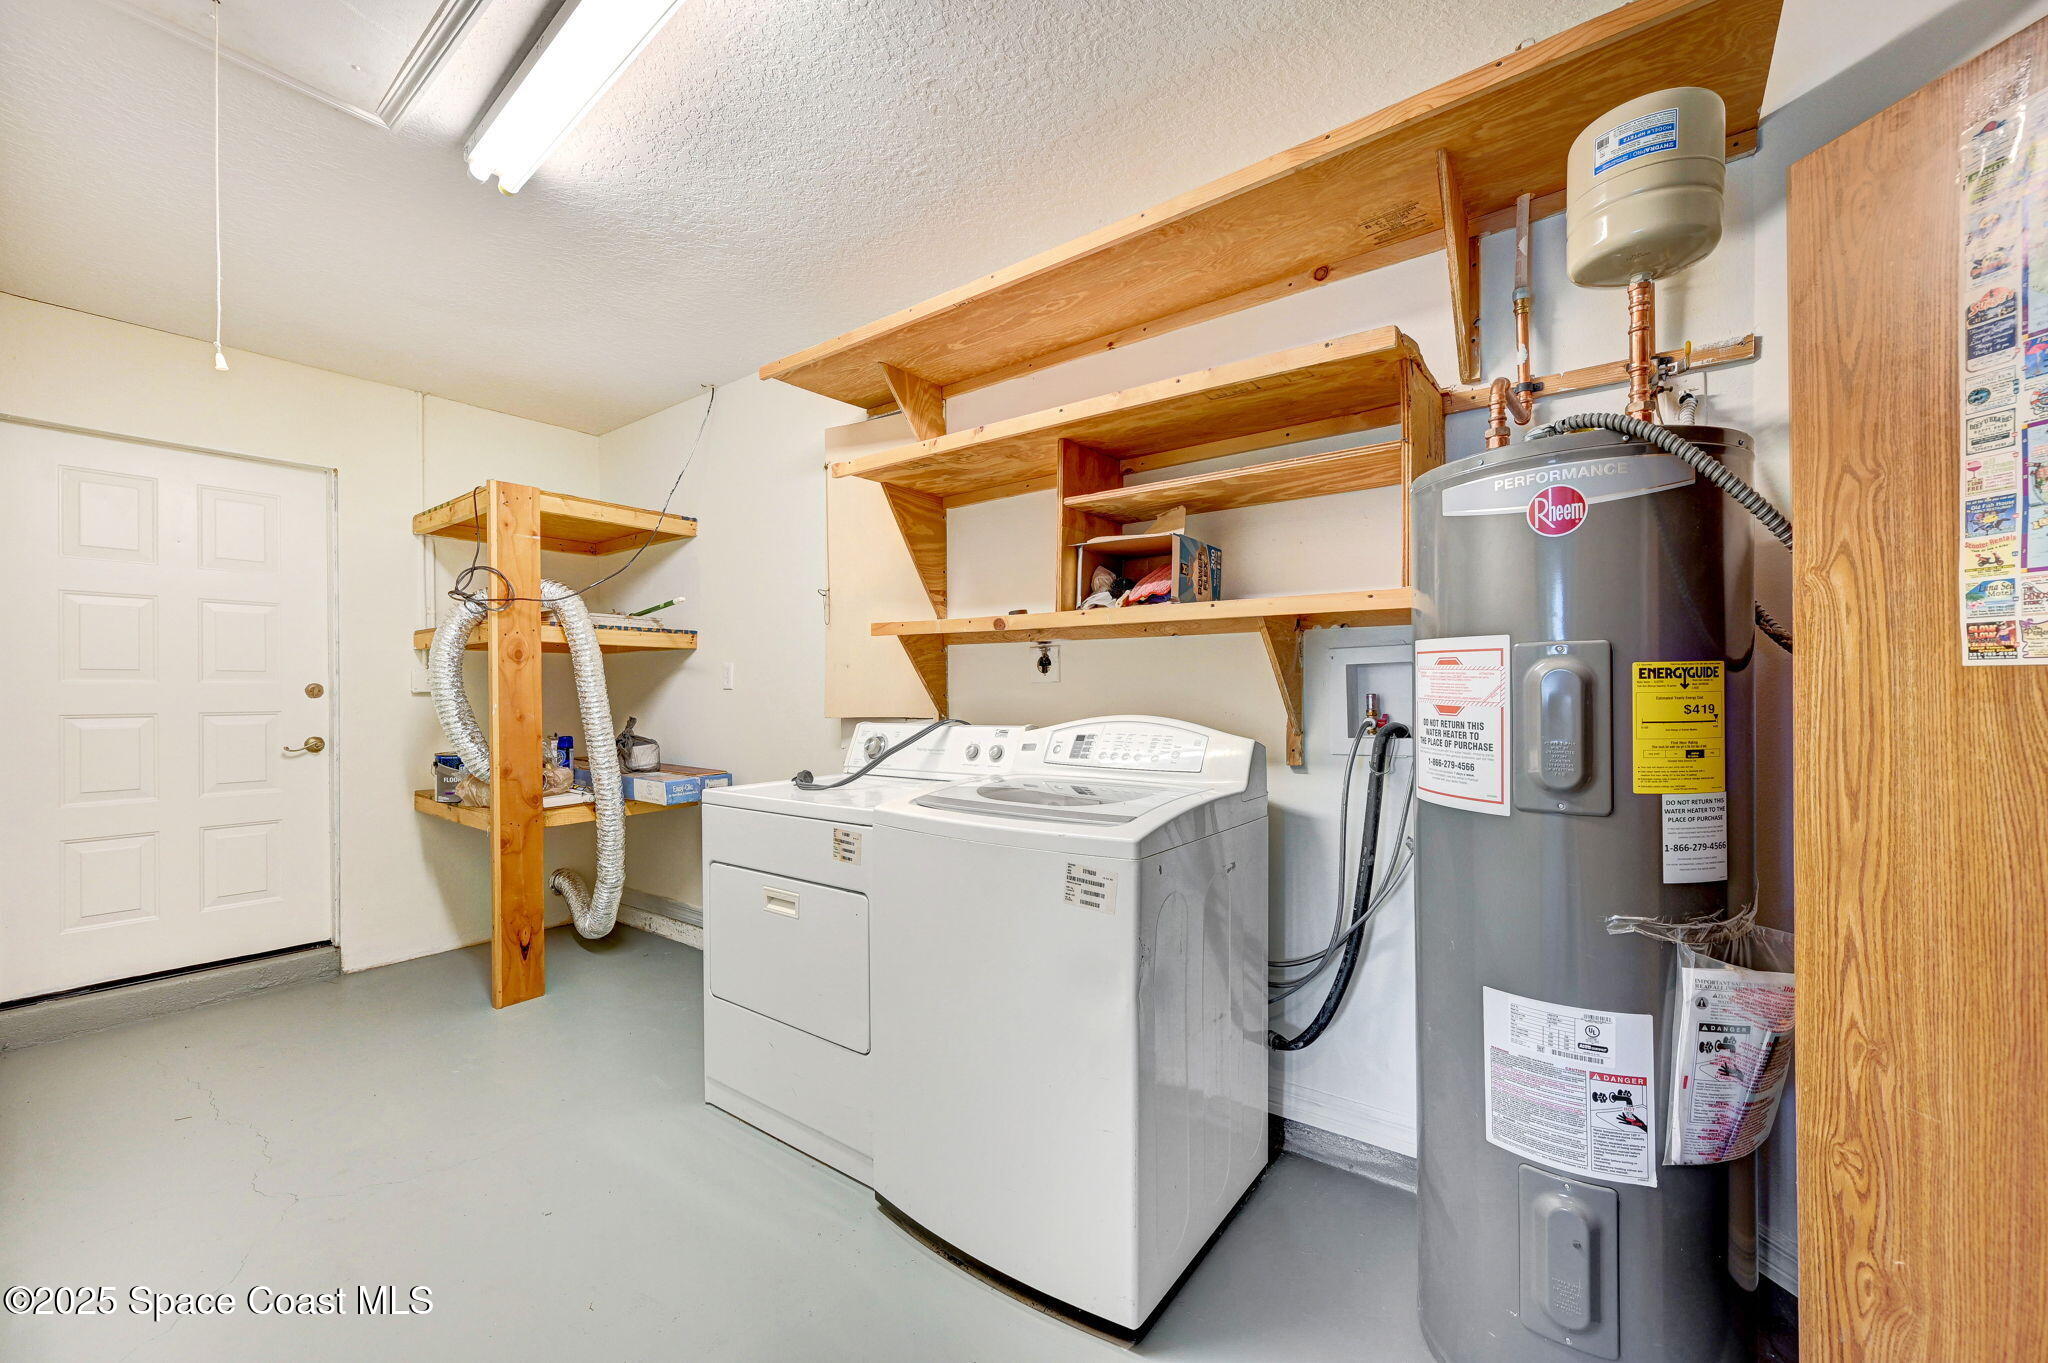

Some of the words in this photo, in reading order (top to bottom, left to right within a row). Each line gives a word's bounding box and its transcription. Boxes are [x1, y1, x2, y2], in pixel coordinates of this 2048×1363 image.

[1494, 462, 1629, 492] PERFORMANCE
[1534, 488, 1584, 528] Rheem
[1965, 541, 1988, 549] Scooter
[1989, 534, 2017, 545] Rentals
[1638, 666, 1719, 680] ENERGYGUIDE
[1683, 704, 1715, 714] $419
[1423, 718, 1428, 726] DO
[1429, 719, 1439, 727] NOT
[1440, 720, 1465, 729] RETURN
[1467, 721, 1485, 730] THIS
[1425, 729, 1442, 738] WATER
[1442, 730, 1467, 740] HEATER
[1469, 731, 1480, 740] TO
[1427, 737, 1443, 747] PLACE
[1444, 738, 1452, 748] OF
[1454, 740, 1494, 752] PURCHASE
[1428, 758, 1475, 771] 1-866-279-4566
[1664, 841, 1727, 852] 1-866-279-4566
[1711, 1025, 1747, 1033] DANGER
[1603, 1075, 1644, 1086] DANGER
